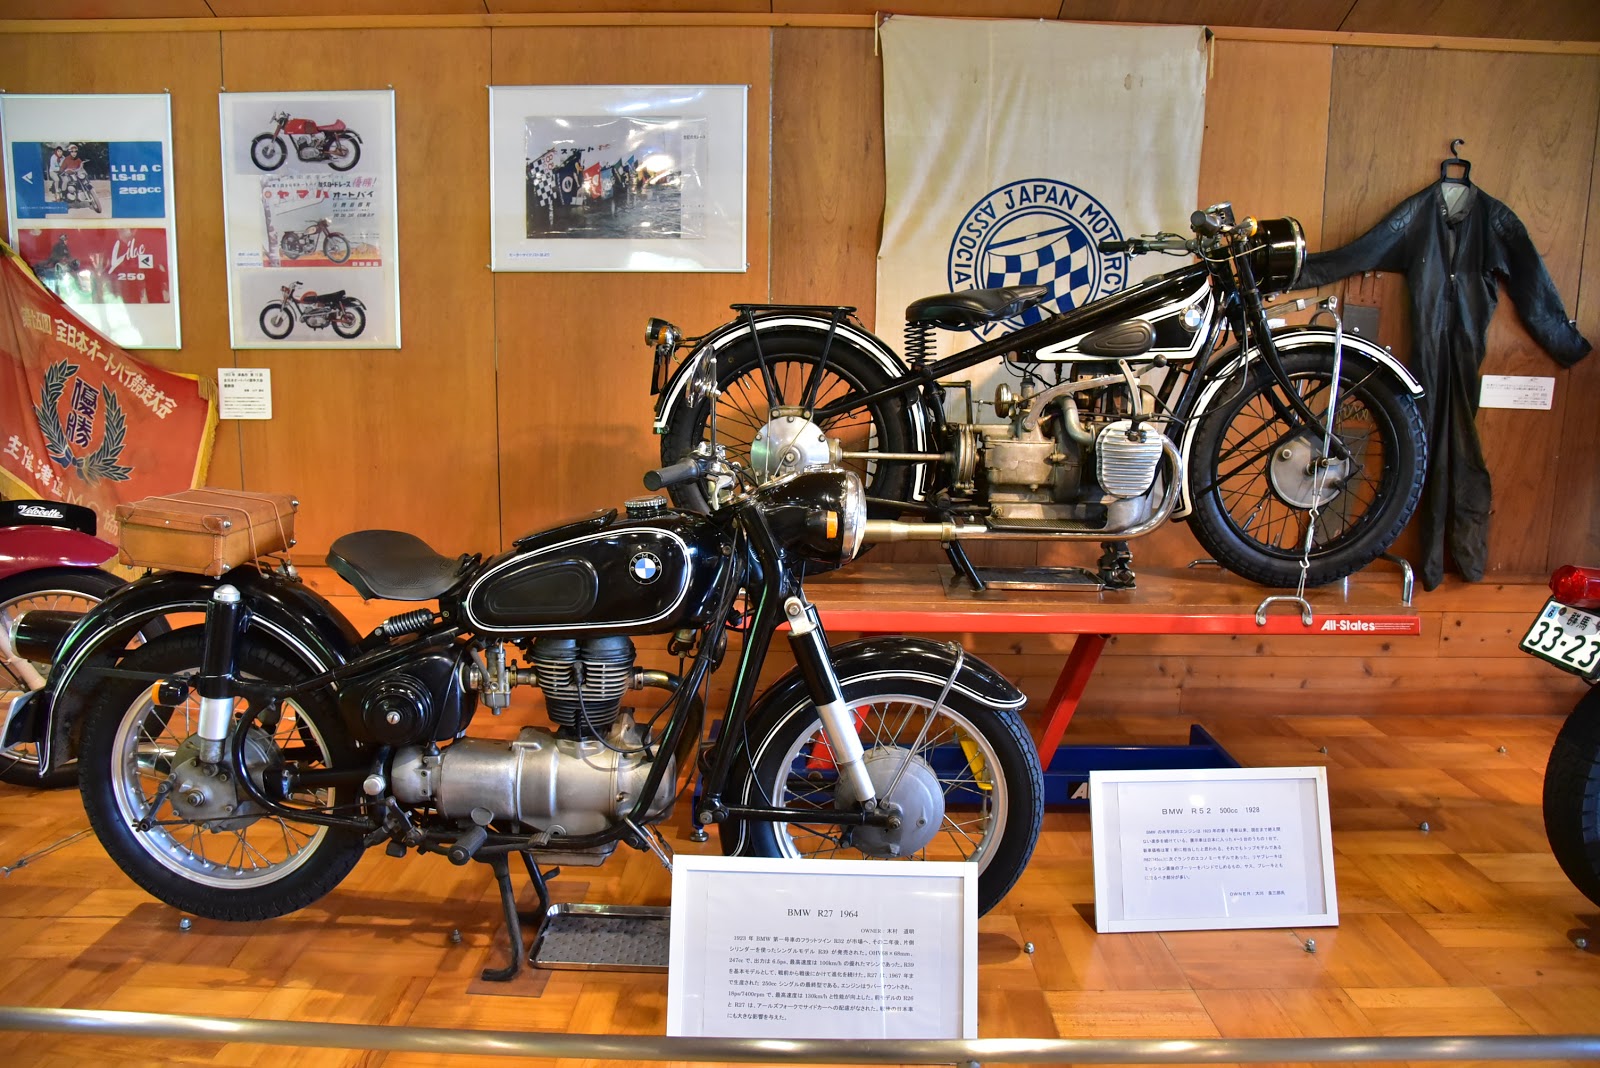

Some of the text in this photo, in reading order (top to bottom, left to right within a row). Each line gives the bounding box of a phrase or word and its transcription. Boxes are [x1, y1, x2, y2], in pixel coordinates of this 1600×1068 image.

[111, 164, 162, 172] LILAC
[277, 190, 330, 199] ヤマハ
[1004, 184, 1078, 210] JAPAN
[118, 272, 146, 280] 250
[66, 378, 100, 448] 優勝
[18, 504, 64, 519] Velocette
[1321, 620, 1376, 631] All-States
[787, 908, 811, 916] BMW
[818, 909, 834, 917] R27
